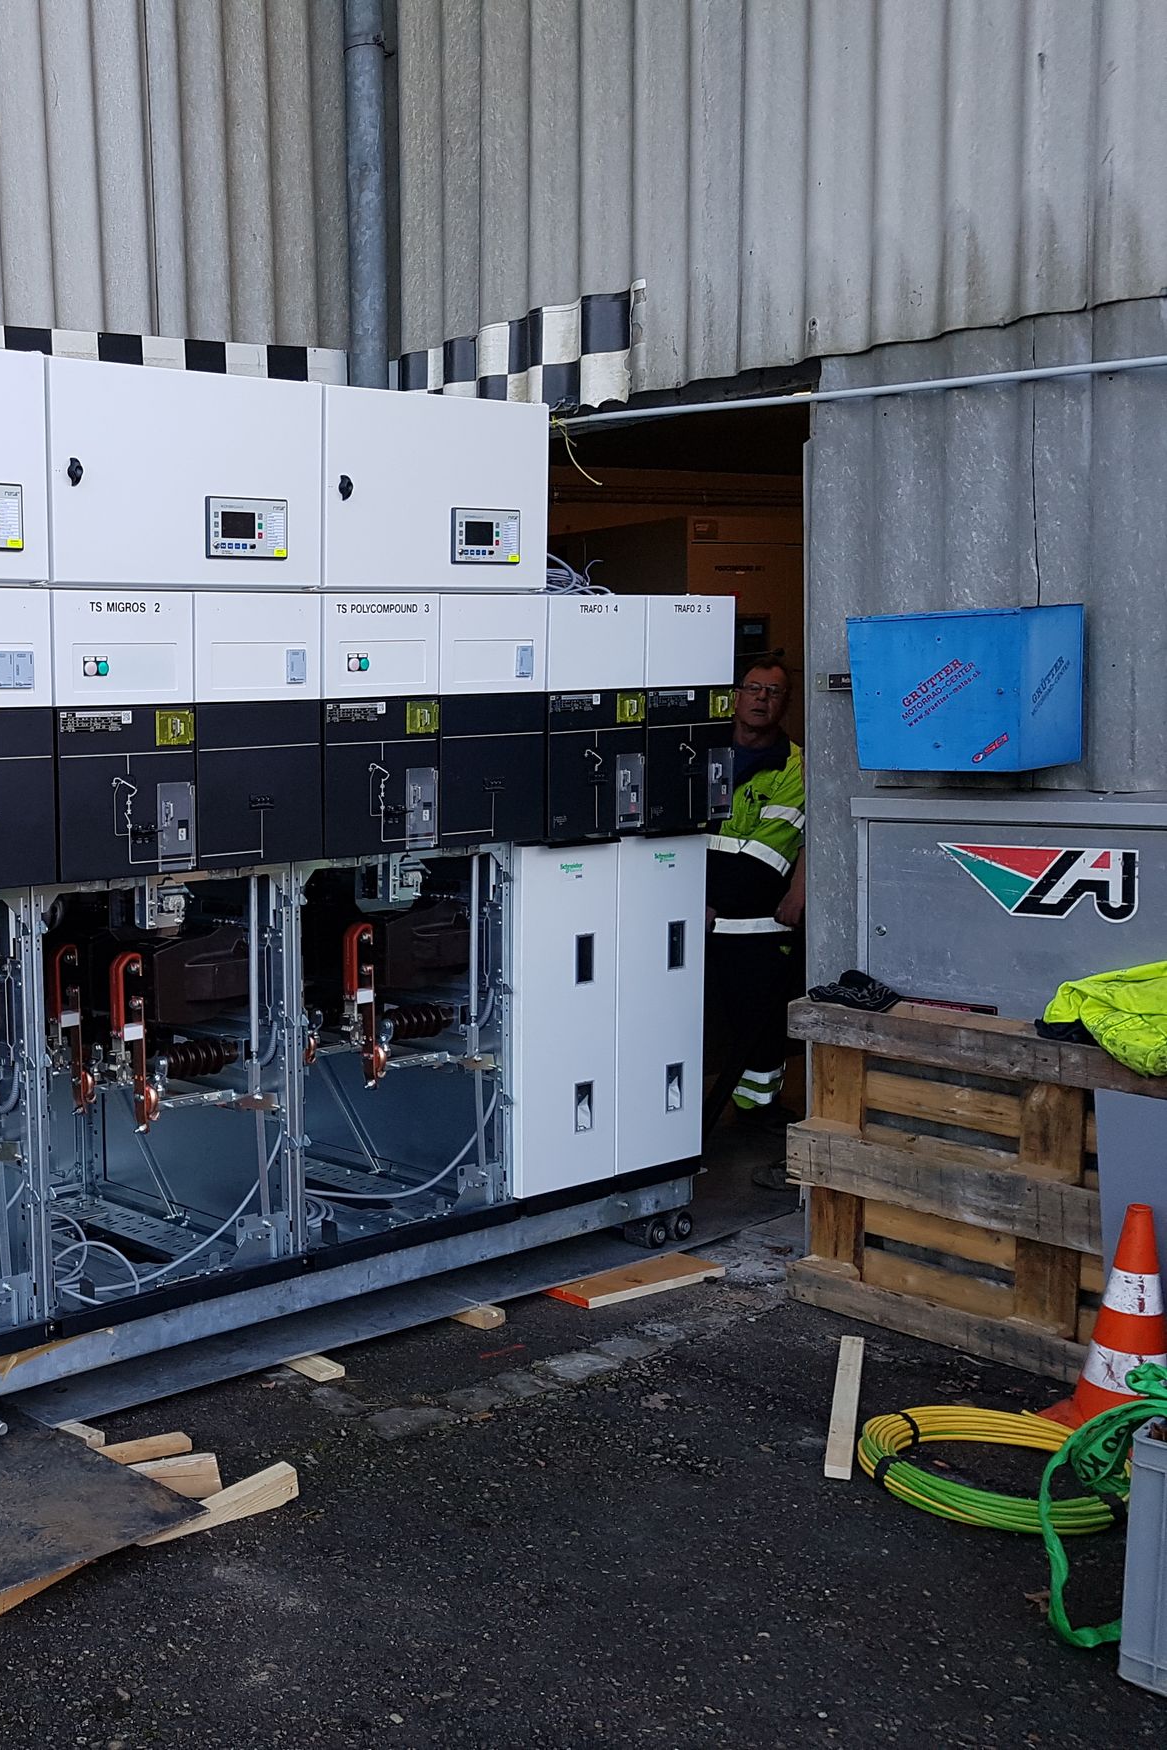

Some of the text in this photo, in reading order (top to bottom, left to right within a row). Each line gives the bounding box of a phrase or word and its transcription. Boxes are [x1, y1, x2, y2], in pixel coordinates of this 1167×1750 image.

[89, 601, 161, 613] TS MIGROS 2
[336, 603, 430, 614] TS POLYCOMPOUND 3
[580, 604, 603, 614] TRAFO
[613, 604, 619, 613] 4
[674, 604, 711, 613] TRAFO 2 5
[902, 658, 963, 708] GRÜTTER
[901, 661, 976, 720] MOTORRAD-CENTER
